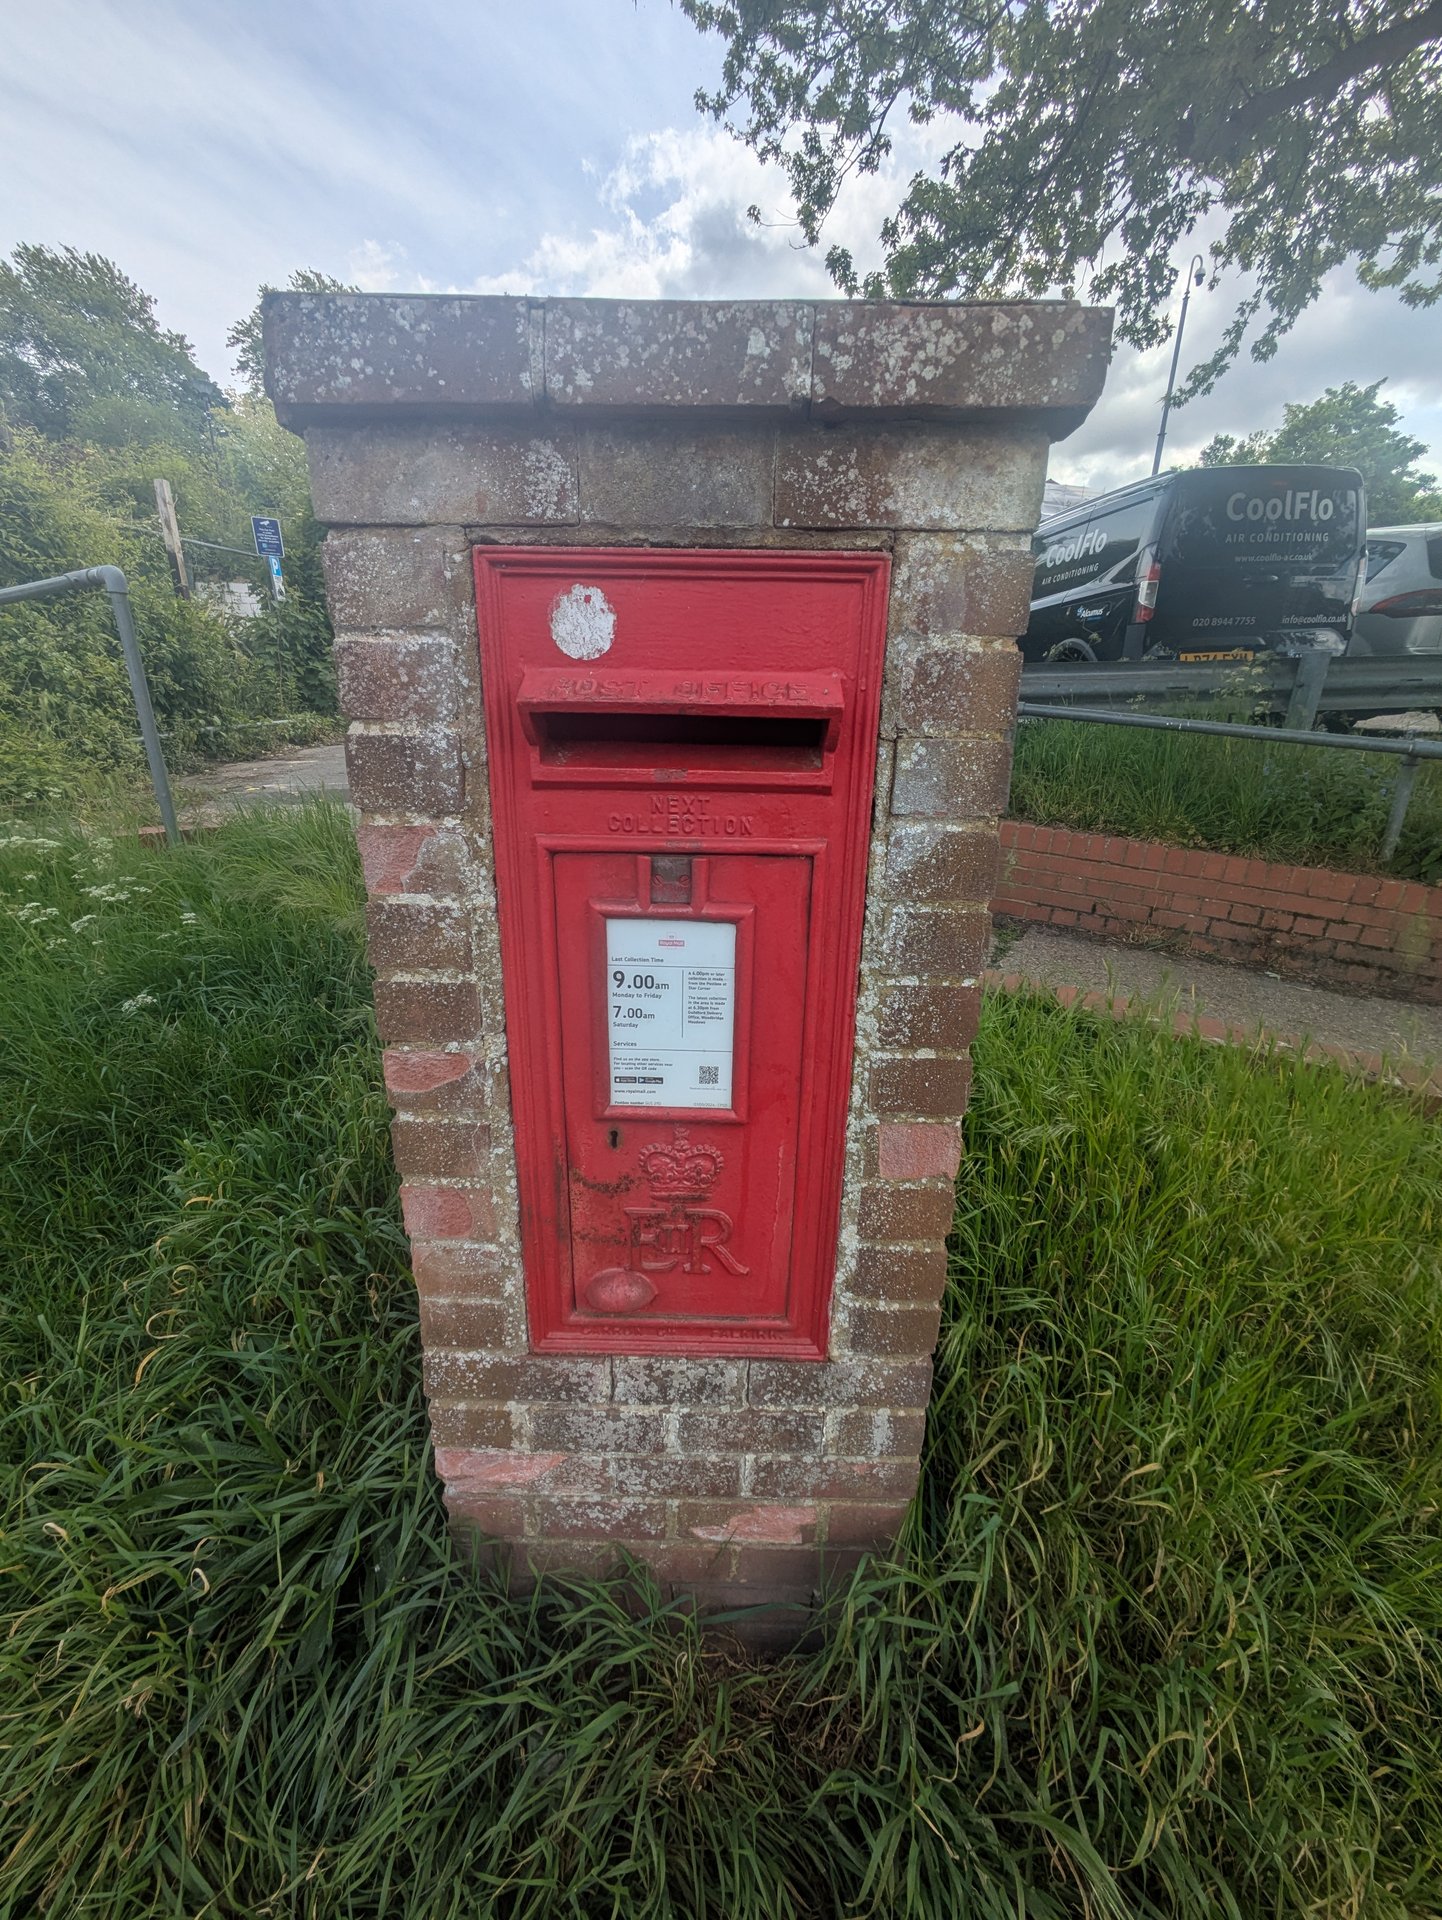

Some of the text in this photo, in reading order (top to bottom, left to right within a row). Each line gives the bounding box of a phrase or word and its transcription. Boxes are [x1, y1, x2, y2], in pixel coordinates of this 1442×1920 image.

[1226, 490, 1334, 521] CoolFlo
[1046, 528, 1107, 568] CoolFlo
[1225, 532, 1329, 544] AIR CONDITIONING
[1052, 562, 1100, 582] CONDITIONING
[1192, 616, 1256, 626] 020 8944 7755
[1282, 614, 1346, 624] info@coolflo.co.uk
[552, 678, 809, 700] POST OFFICE
[650, 796, 710, 816] NEXT
[607, 815, 754, 836] COLLECTION
[613, 970, 670, 990] 9.00am
[613, 1006, 655, 1019] 7.00am
